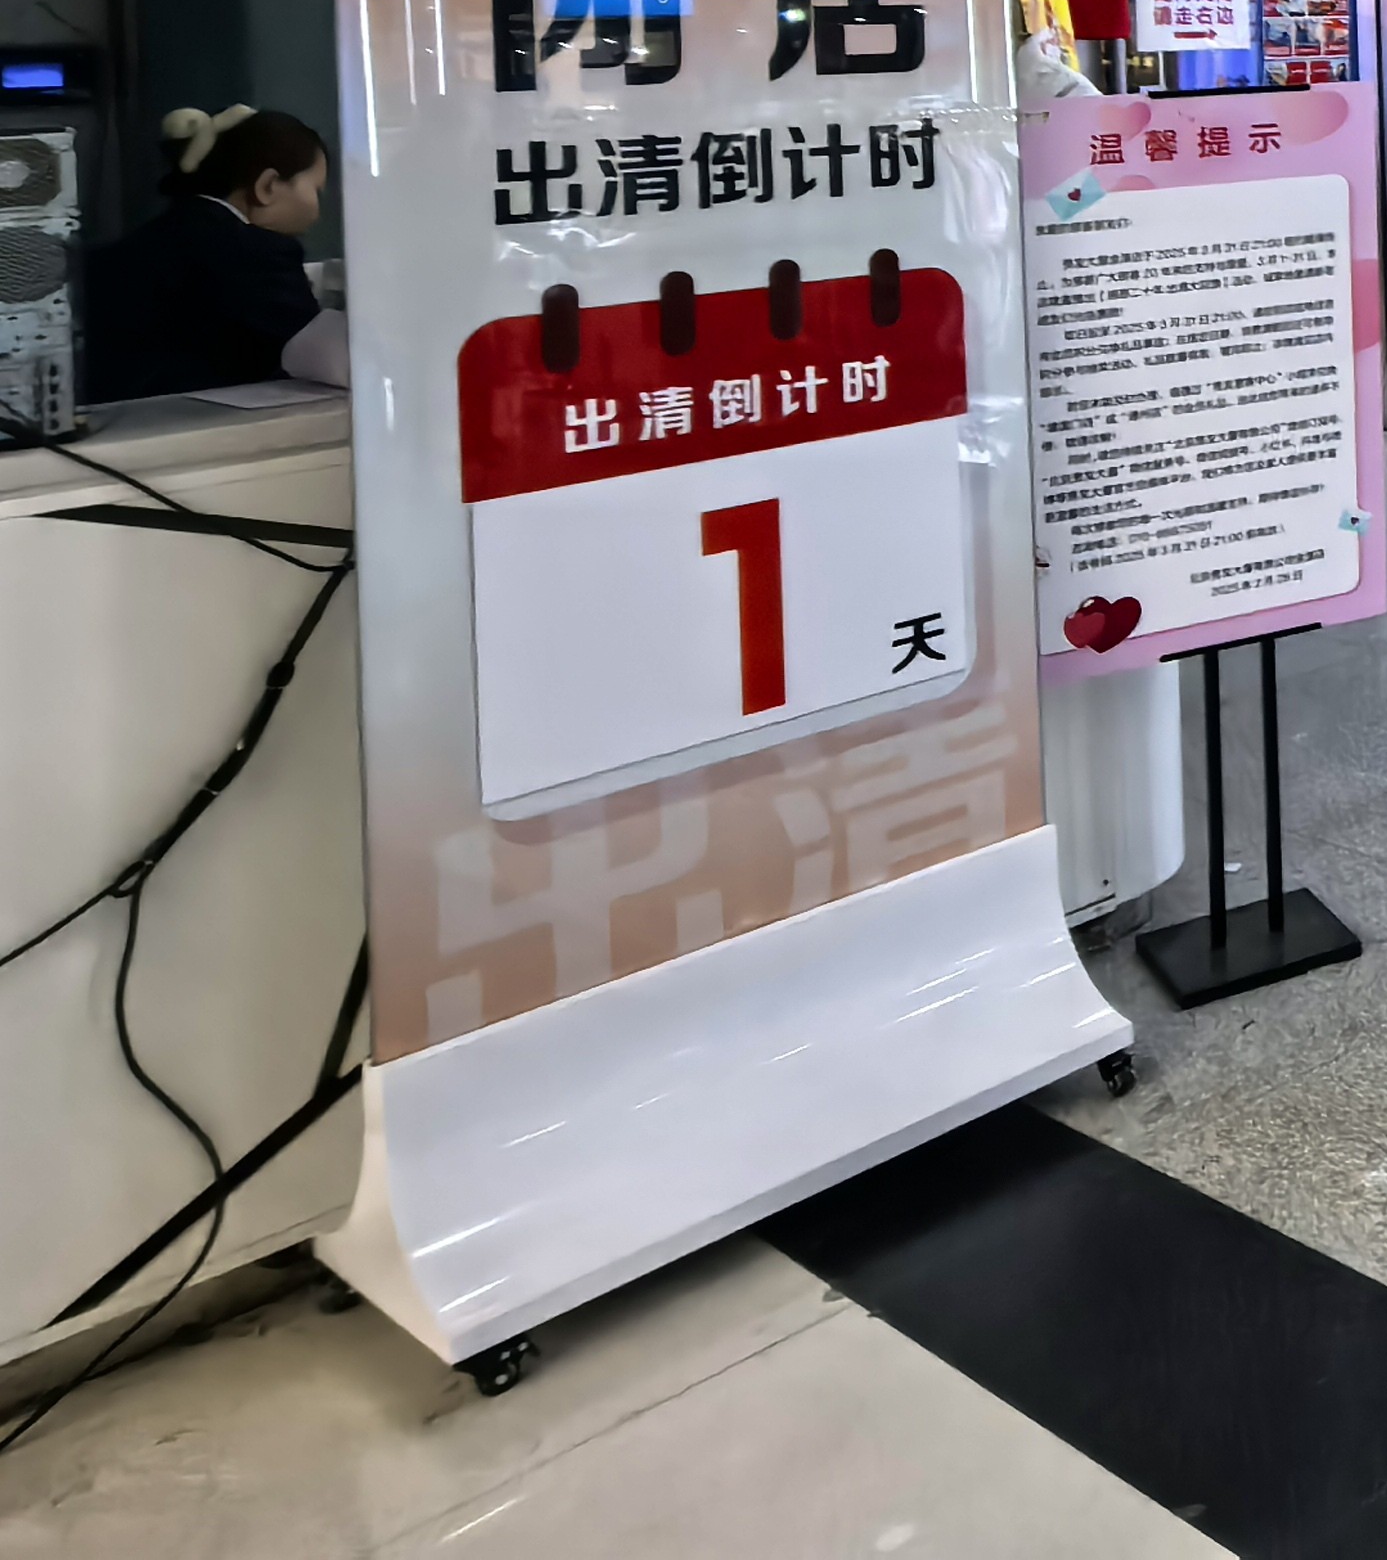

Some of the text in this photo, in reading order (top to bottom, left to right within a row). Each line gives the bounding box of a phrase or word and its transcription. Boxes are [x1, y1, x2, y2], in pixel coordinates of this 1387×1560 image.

[494, 117, 940, 226] 出清倒计时
[1089, 122, 1283, 167] 温馨提示
[563, 354, 892, 455] 出清倒计时
[700, 497, 787, 718] 1
[891, 611, 947, 675] 天
